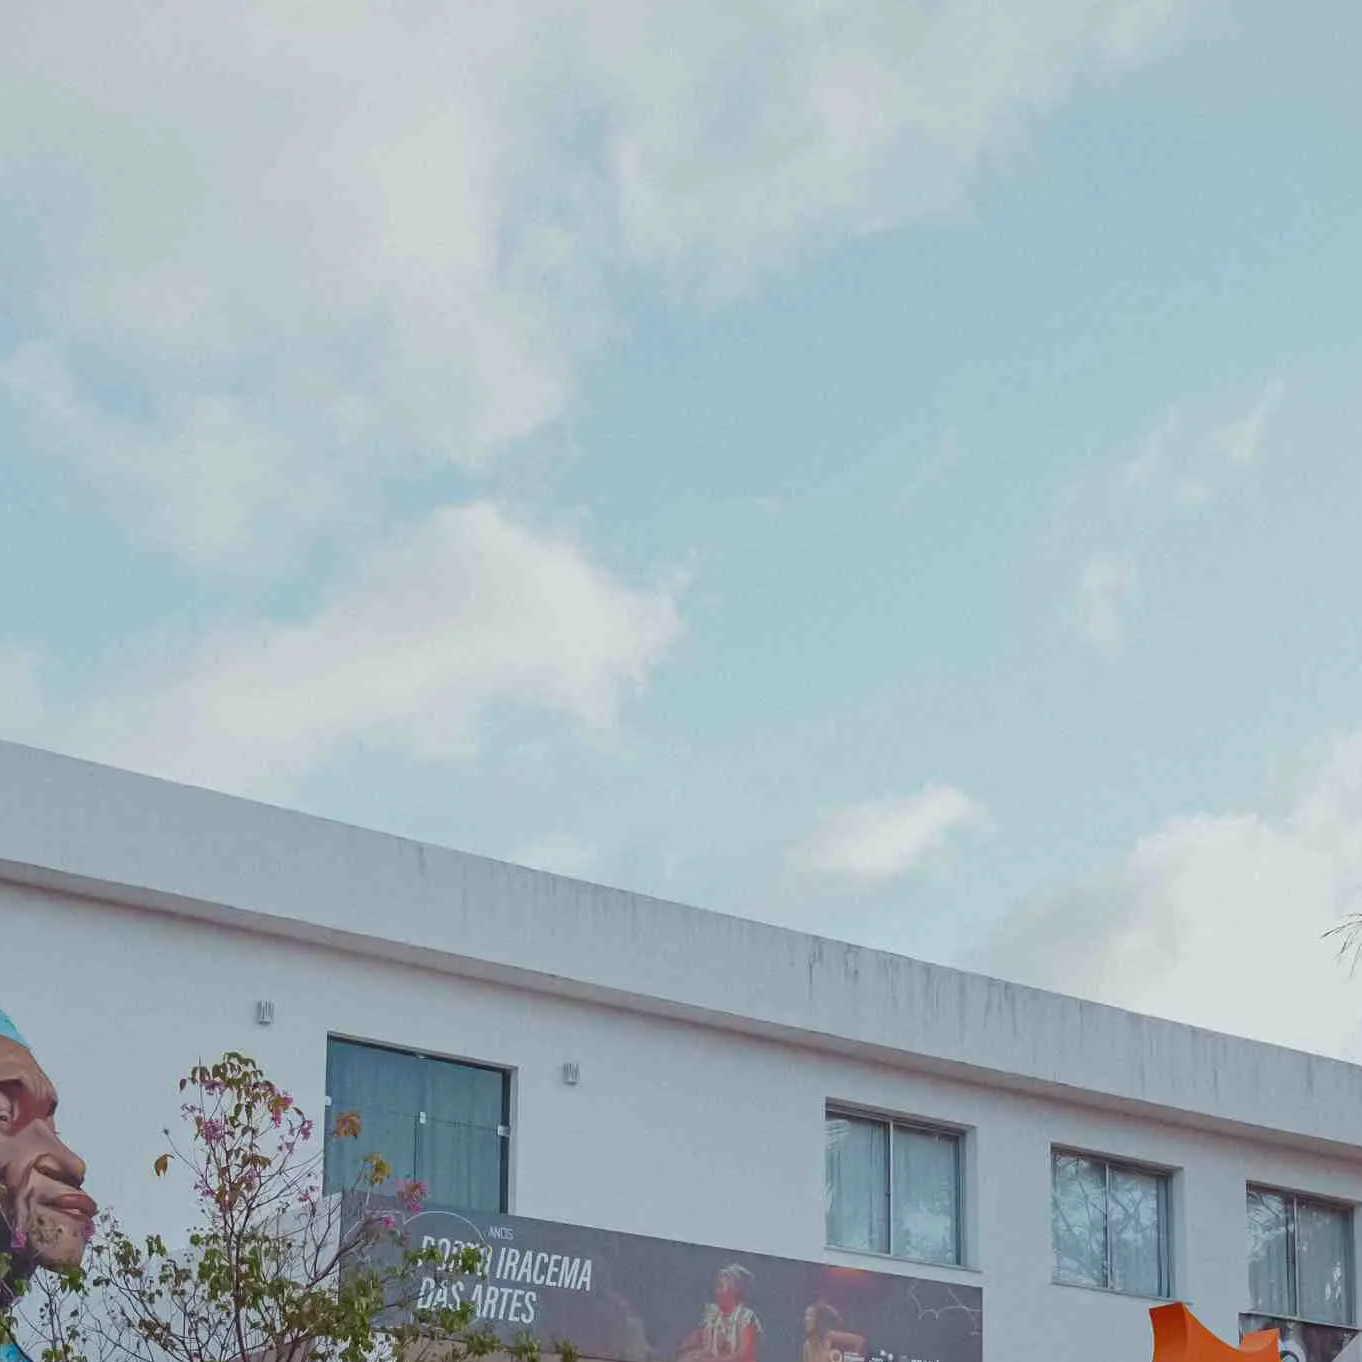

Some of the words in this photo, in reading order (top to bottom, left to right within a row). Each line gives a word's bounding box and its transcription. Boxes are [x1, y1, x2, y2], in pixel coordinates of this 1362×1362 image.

[488, 1225, 514, 1241] ANOS
[495, 1246, 594, 1292] IRACEMA
[417, 1276, 464, 1312] DAS
[471, 1283, 538, 1325] ARTES
